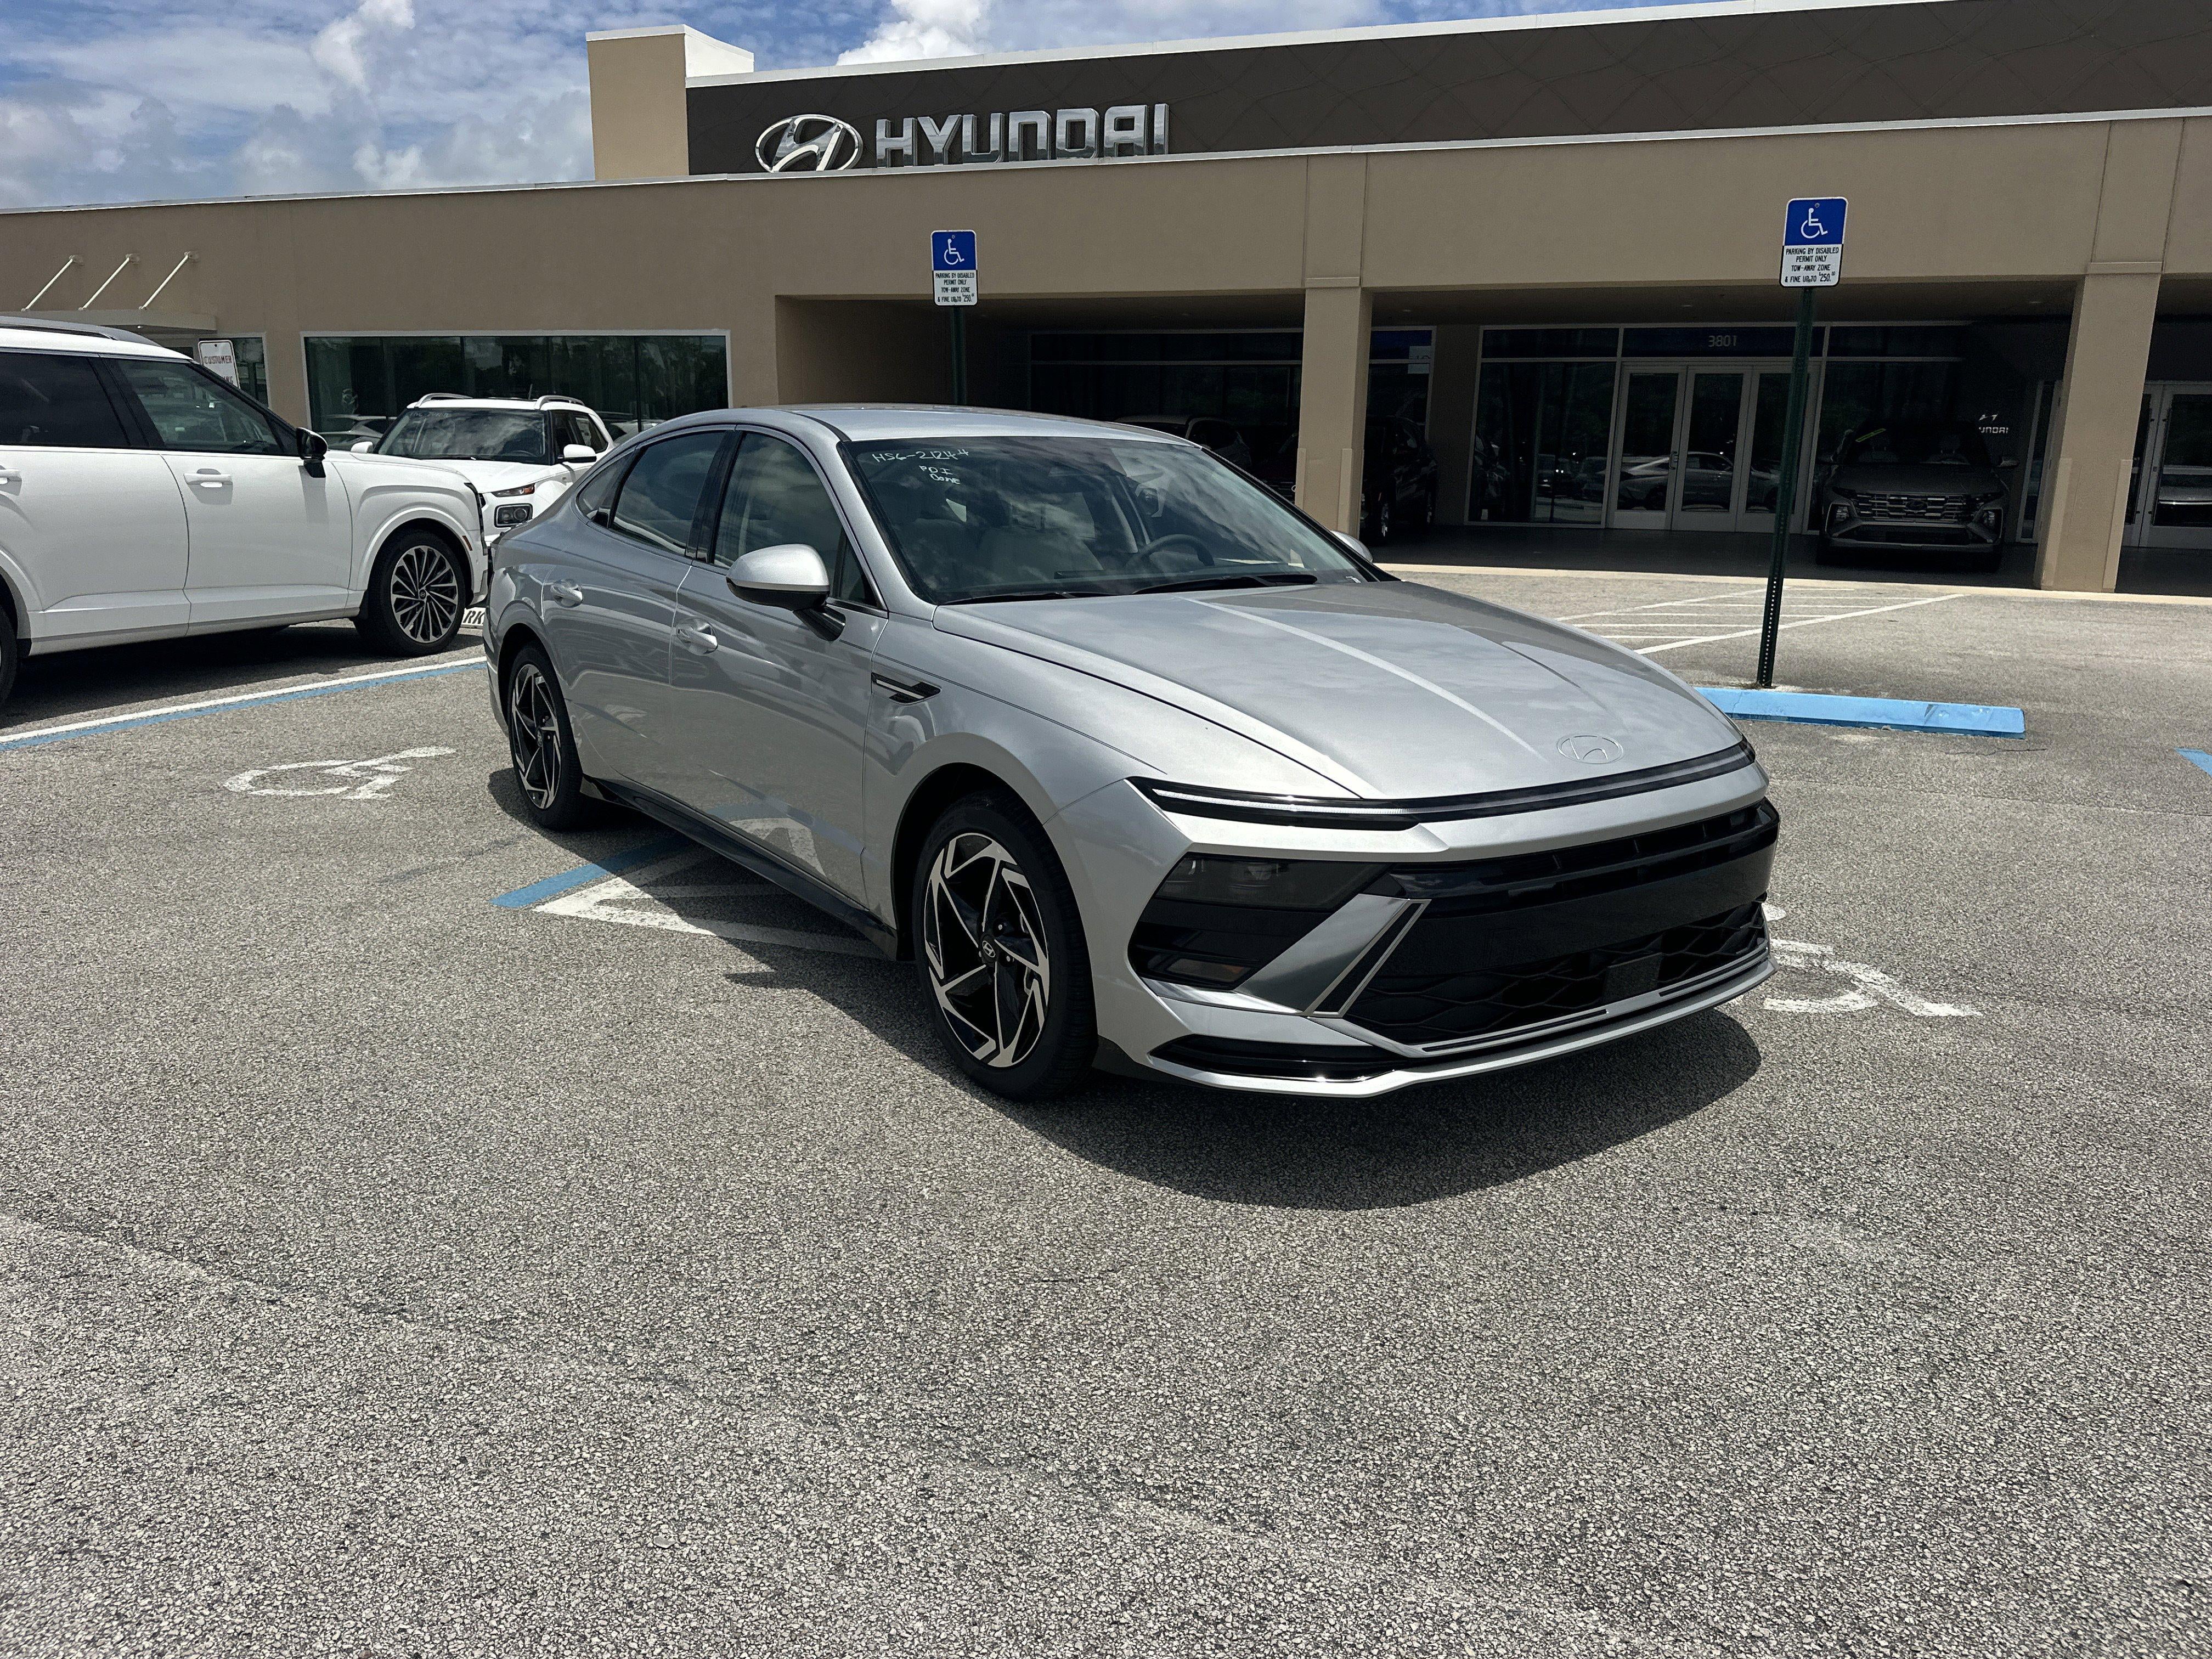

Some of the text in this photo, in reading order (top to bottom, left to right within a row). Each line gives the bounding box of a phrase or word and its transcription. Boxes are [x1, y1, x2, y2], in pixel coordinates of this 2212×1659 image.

[876, 103, 1170, 168] HYUNDAI
[1708, 335, 1737, 347] 3801
[204, 356, 233, 364] CUSTOMER
